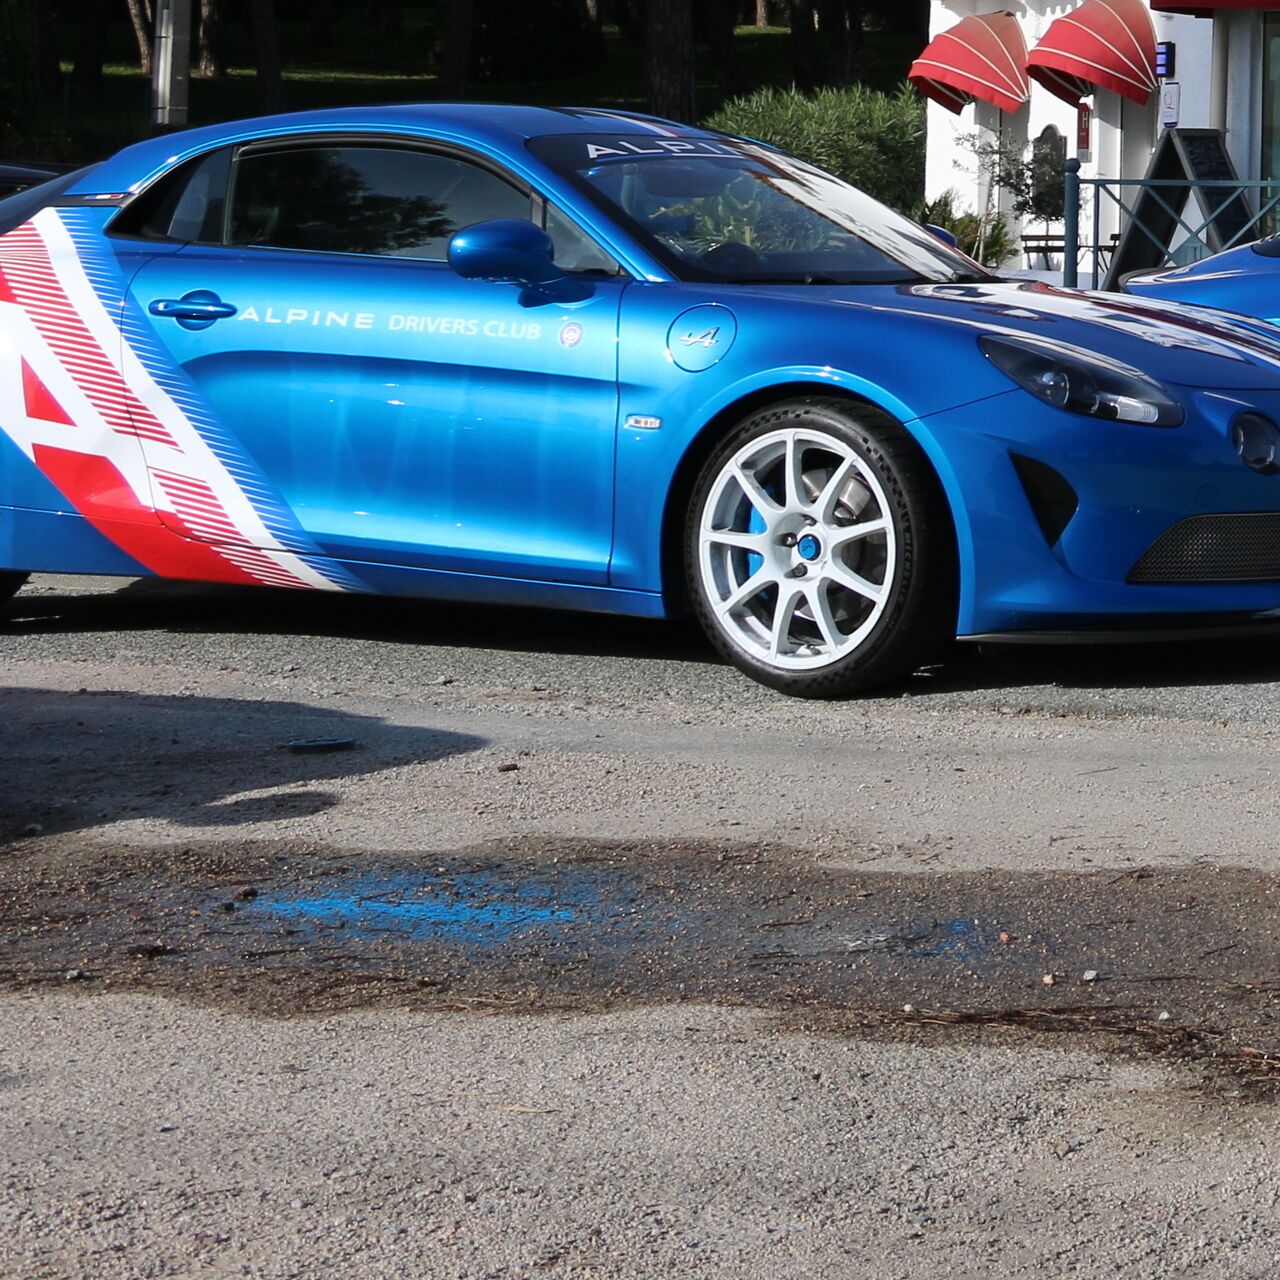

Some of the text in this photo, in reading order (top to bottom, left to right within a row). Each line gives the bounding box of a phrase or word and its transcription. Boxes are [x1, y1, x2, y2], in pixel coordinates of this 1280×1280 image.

[238, 307, 376, 329] ALPINE
[388, 314, 479, 336] DRIVERS
[483, 320, 542, 340] CLUB
